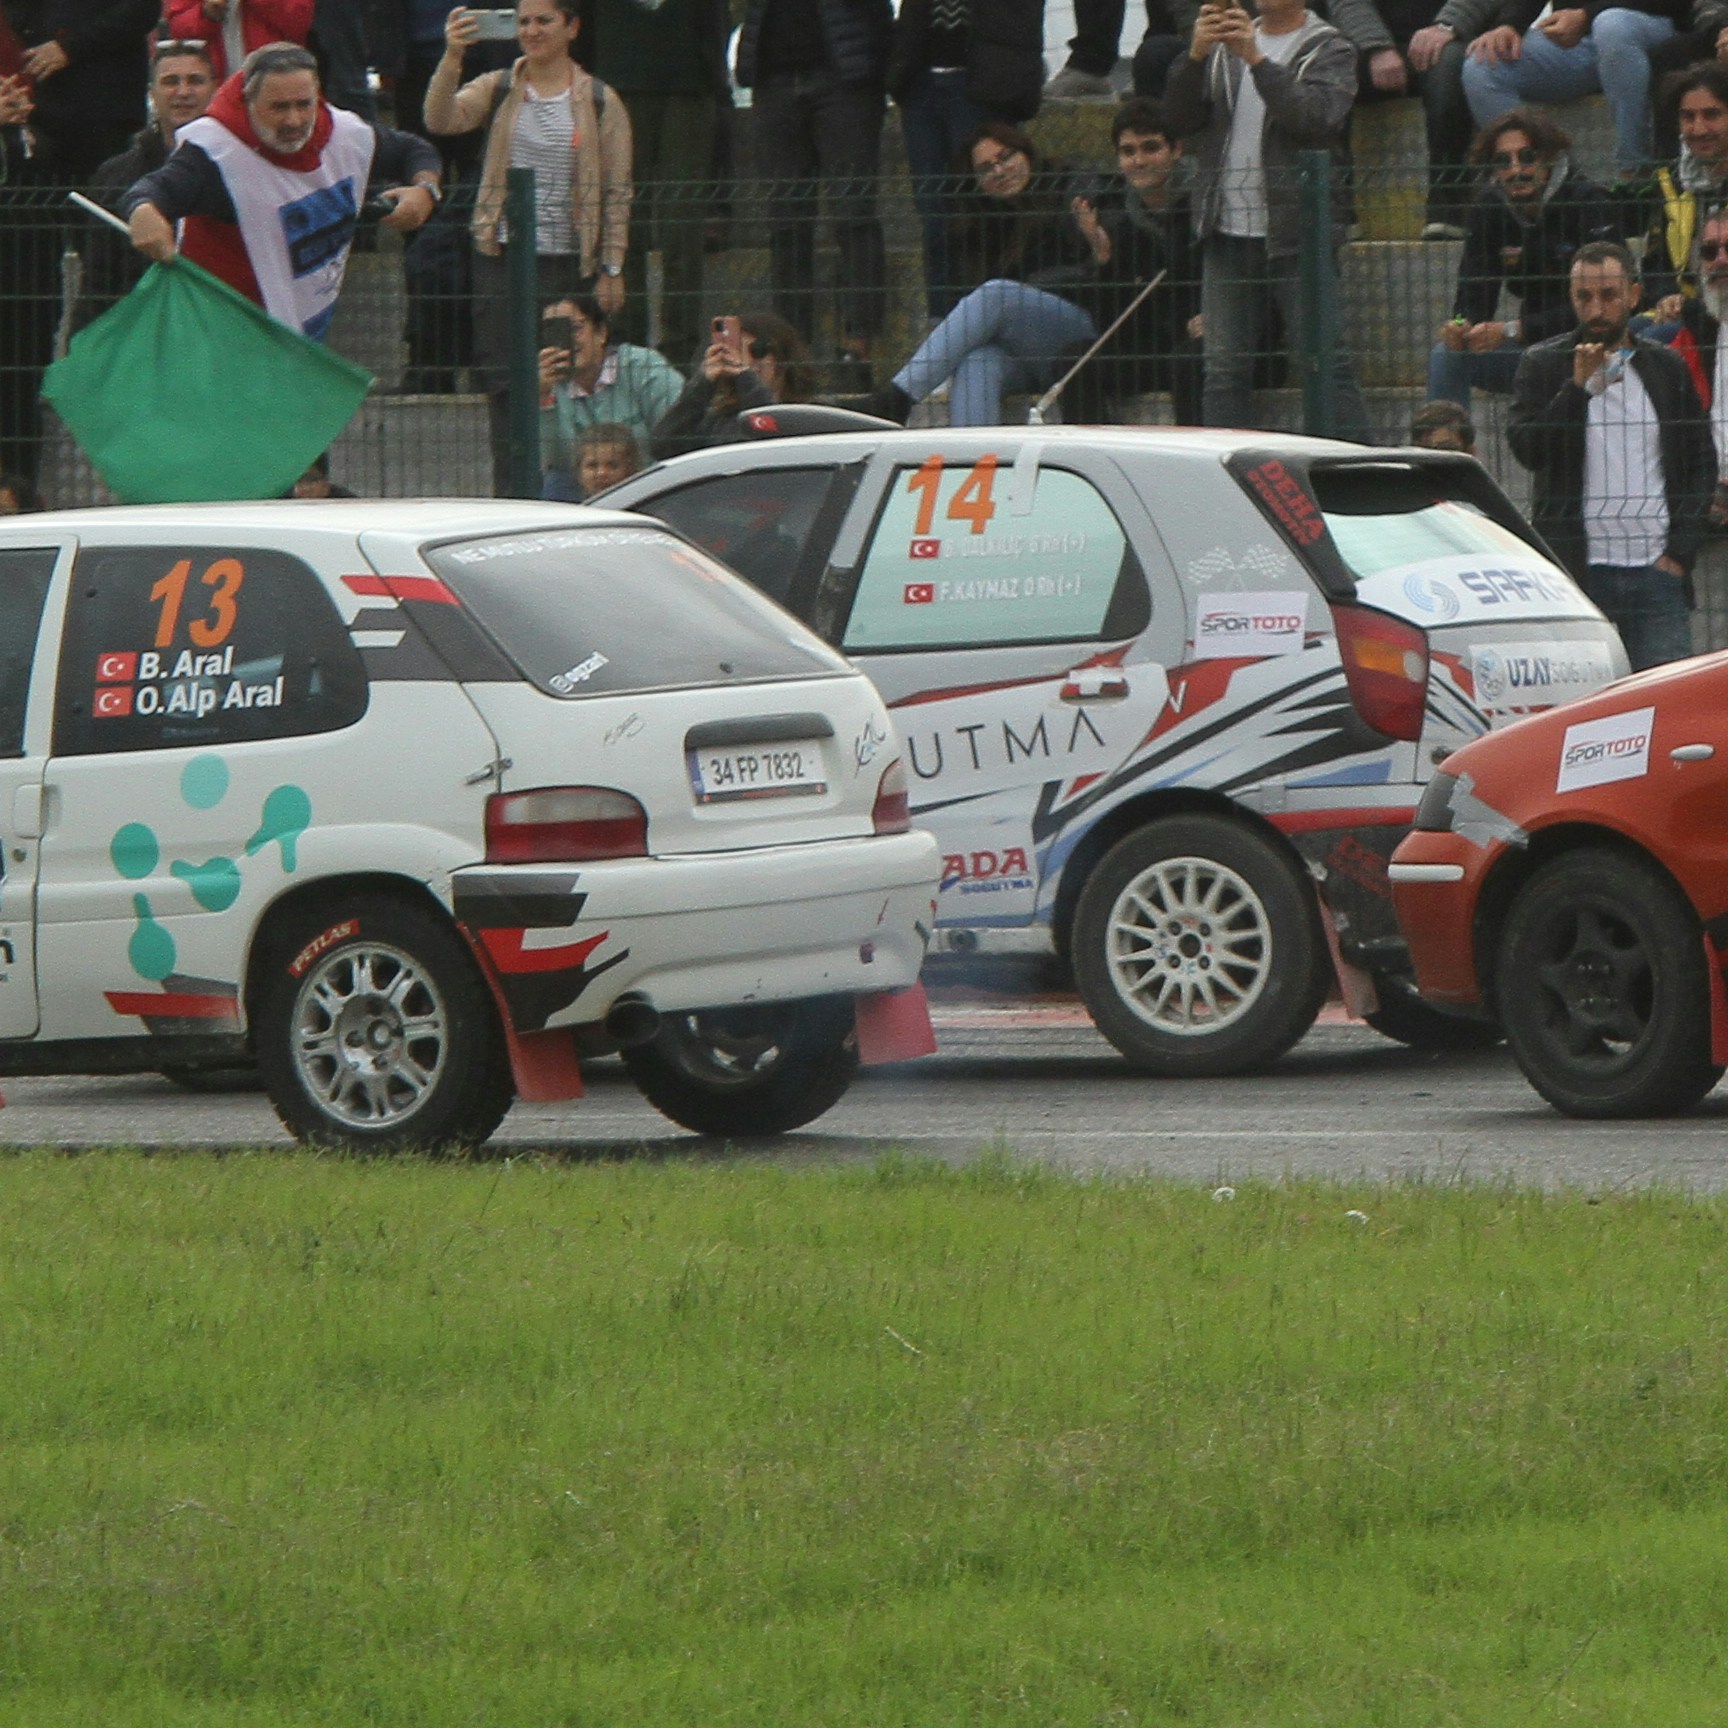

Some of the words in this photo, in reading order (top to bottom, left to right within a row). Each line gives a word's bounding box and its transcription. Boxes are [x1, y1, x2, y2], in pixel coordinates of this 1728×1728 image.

[906, 453, 999, 535] 14
[1260, 460, 1324, 541] DEHA
[149, 558, 245, 648] 13
[138, 652, 169, 681] B.
[173, 645, 235, 678] Aral
[135, 681, 217, 719] O.Alp
[222, 675, 285, 710] Aral
[710, 759, 733, 785] 34
[737, 758, 759, 783] FP
[762, 752, 805, 781] 7832
[942, 847, 1029, 880] ADA
